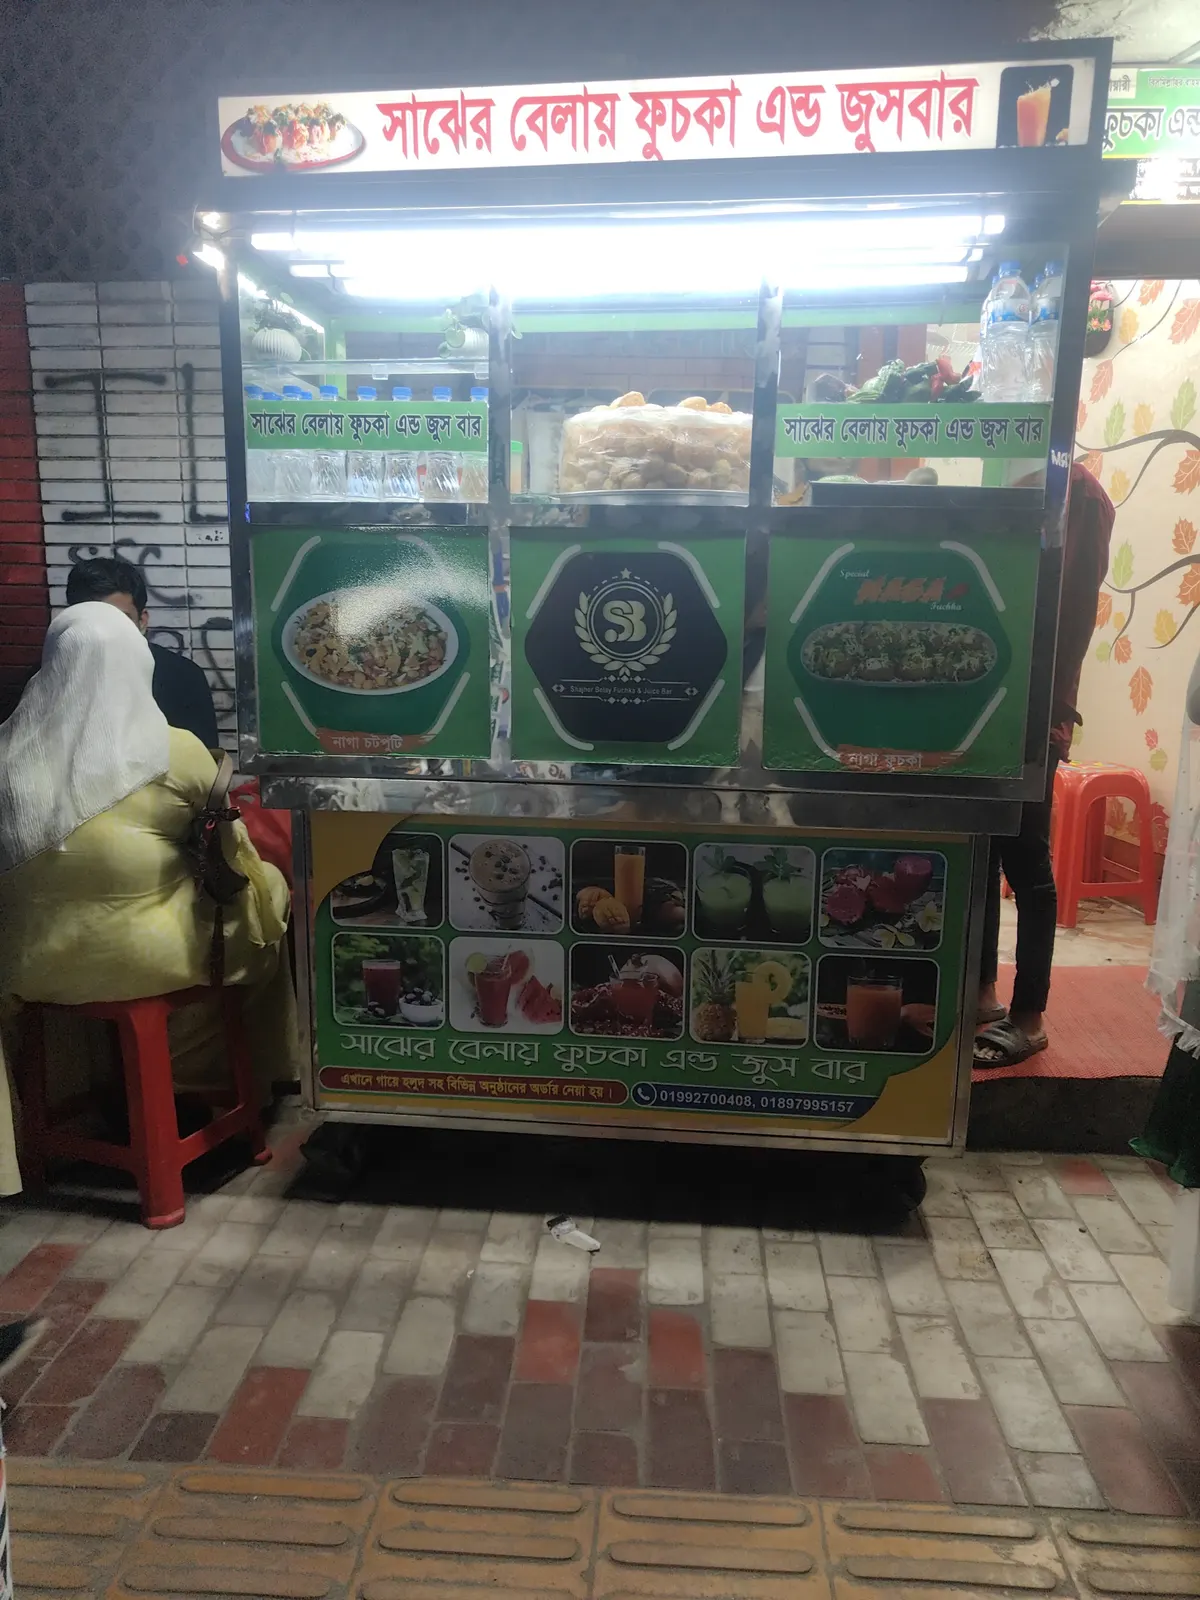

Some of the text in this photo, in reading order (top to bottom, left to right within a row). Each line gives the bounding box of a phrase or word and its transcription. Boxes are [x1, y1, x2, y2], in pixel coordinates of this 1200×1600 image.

[376, 89, 496, 160] সাঝের
[510, 84, 621, 153] বেলায়
[629, 78, 742, 161] ফুচকা
[249, 410, 297, 437] সাঝের
[301, 410, 344, 437] বেলায়
[348, 410, 391, 445] ফুচকা
[424, 413, 452, 443] জুস
[455, 410, 482, 438] বার
[782, 414, 836, 444] সাঝের
[840, 414, 890, 444] বেলায়
[892, 414, 941, 451] ফুচকা
[979, 417, 1009, 450] জুস
[1014, 414, 1045, 444] বার
[340, 1033, 436, 1061] সাঝের
[447, 1039, 541, 1067] বেলায়
[552, 1042, 649, 1074] ফুচকা
[731, 1053, 800, 1086] জুস
[810, 1058, 868, 1084] বার
[341, 1073, 373, 1087] এখানে
[376, 1074, 400, 1088] গায়ে
[401, 1076, 425, 1091] হলুদ
[427, 1077, 444, 1092] সহ
[529, 1079, 560, 1095] অর্ডার
[562, 1084, 586, 1097] নেয়া
[587, 1085, 604, 1099] হয়
[660, 1090, 855, 1113] 01992700408, 01897995157
